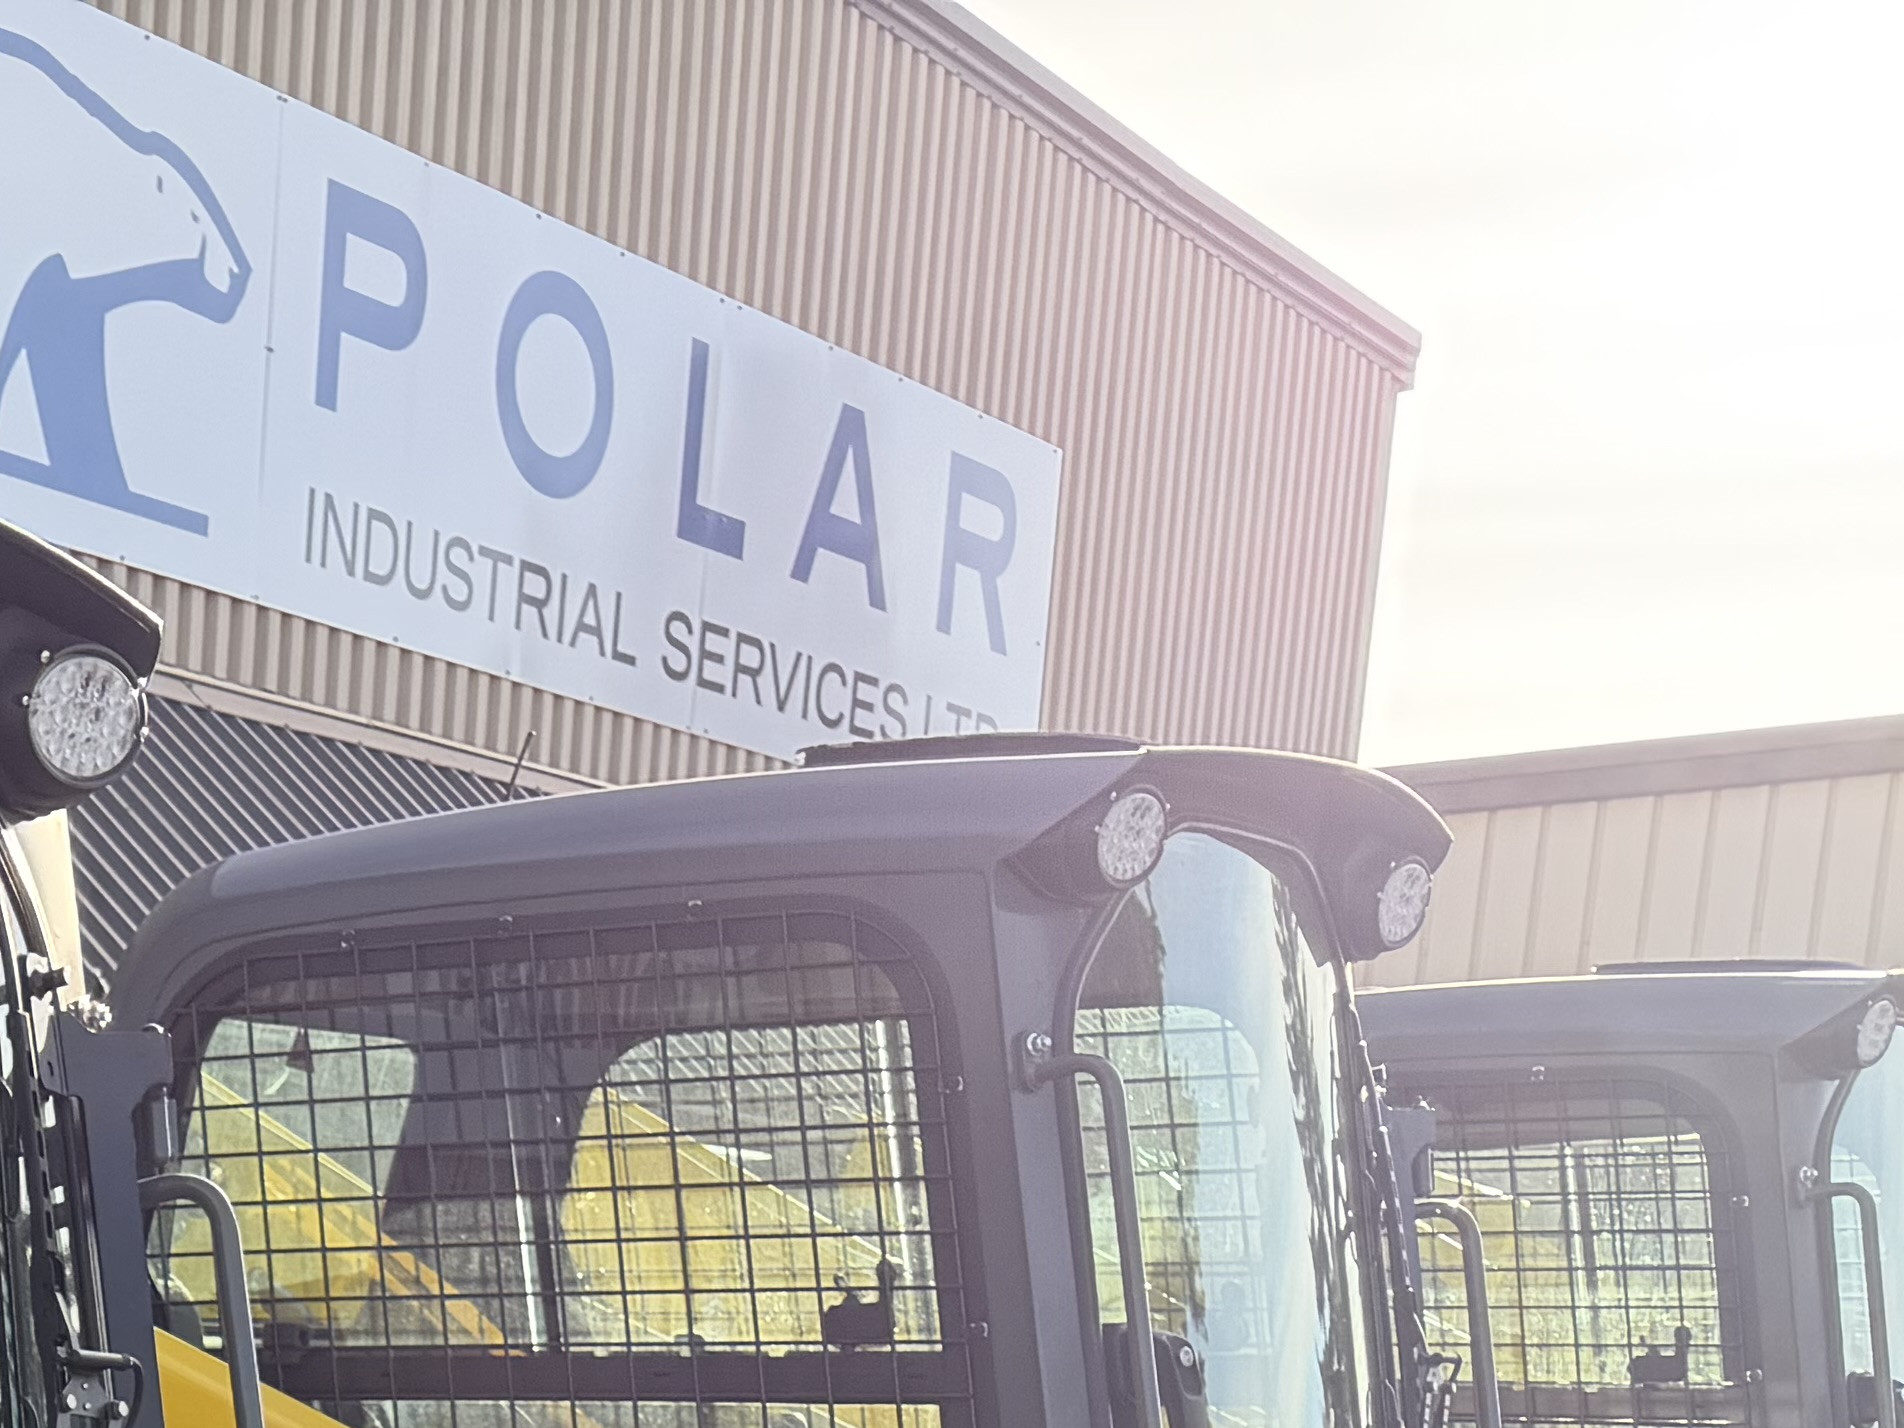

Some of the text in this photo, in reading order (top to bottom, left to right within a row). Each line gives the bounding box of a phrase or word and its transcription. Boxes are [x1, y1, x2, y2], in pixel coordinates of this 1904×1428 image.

[316, 179, 1016, 656] POLAR
[304, 486, 636, 667] INDUSTRIAL
[661, 606, 908, 740] SERVICES
